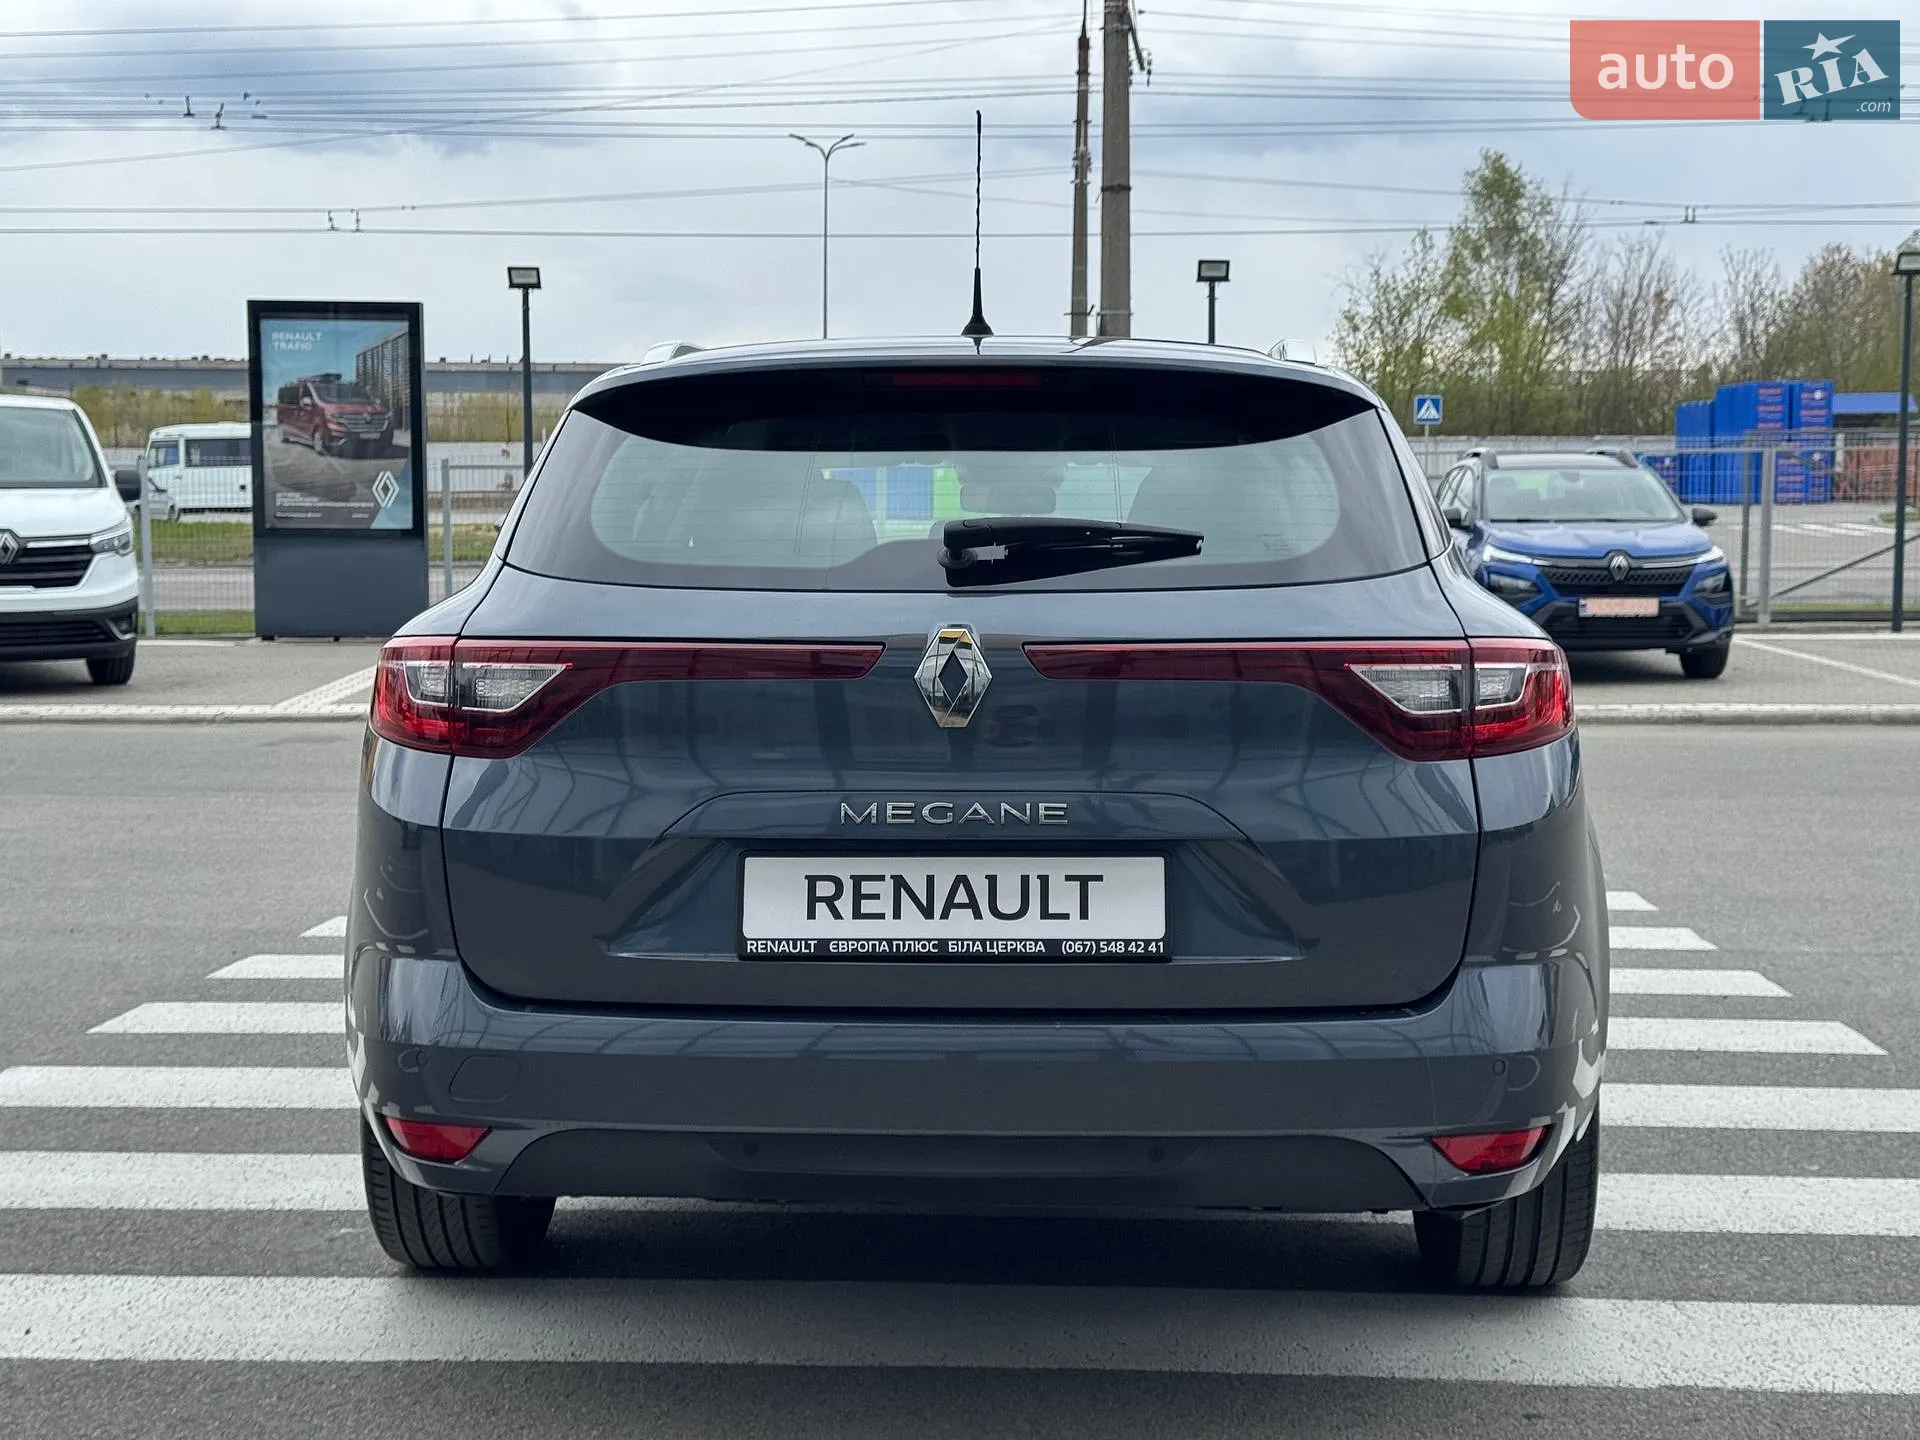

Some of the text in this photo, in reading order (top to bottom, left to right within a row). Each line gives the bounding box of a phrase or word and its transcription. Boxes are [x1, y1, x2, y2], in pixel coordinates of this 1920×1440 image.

[271, 331, 323, 341] RENAULT
[840, 802, 1069, 825] MEGANE
[804, 874, 1104, 921] RENAULT
[747, 940, 1164, 955] RENAULT ЄВРОПА ПЛЮС БІЛА ЦЕРКВА (067) 548 42 41
